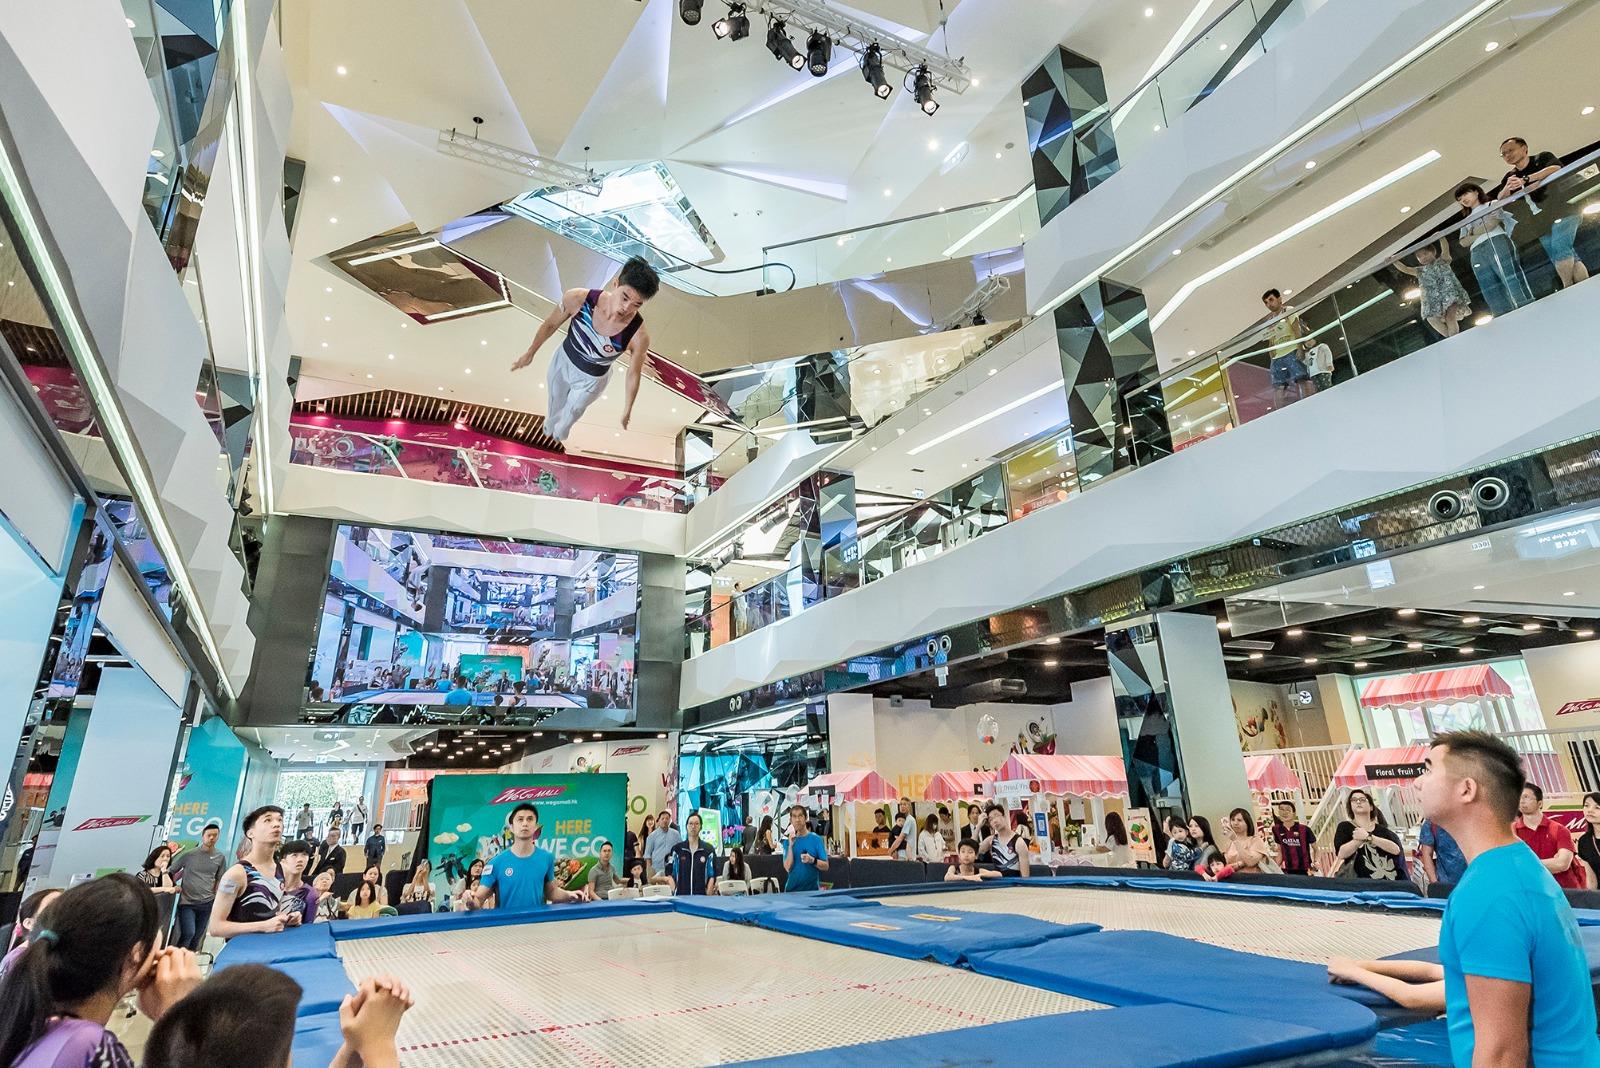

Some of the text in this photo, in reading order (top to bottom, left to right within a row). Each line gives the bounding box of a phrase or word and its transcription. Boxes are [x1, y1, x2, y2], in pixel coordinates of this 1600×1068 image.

[1375, 768, 1395, 777] Floral
[1398, 767, 1414, 776] Fruit
[535, 788, 561, 799] MALL
[555, 819, 592, 835] HERE
